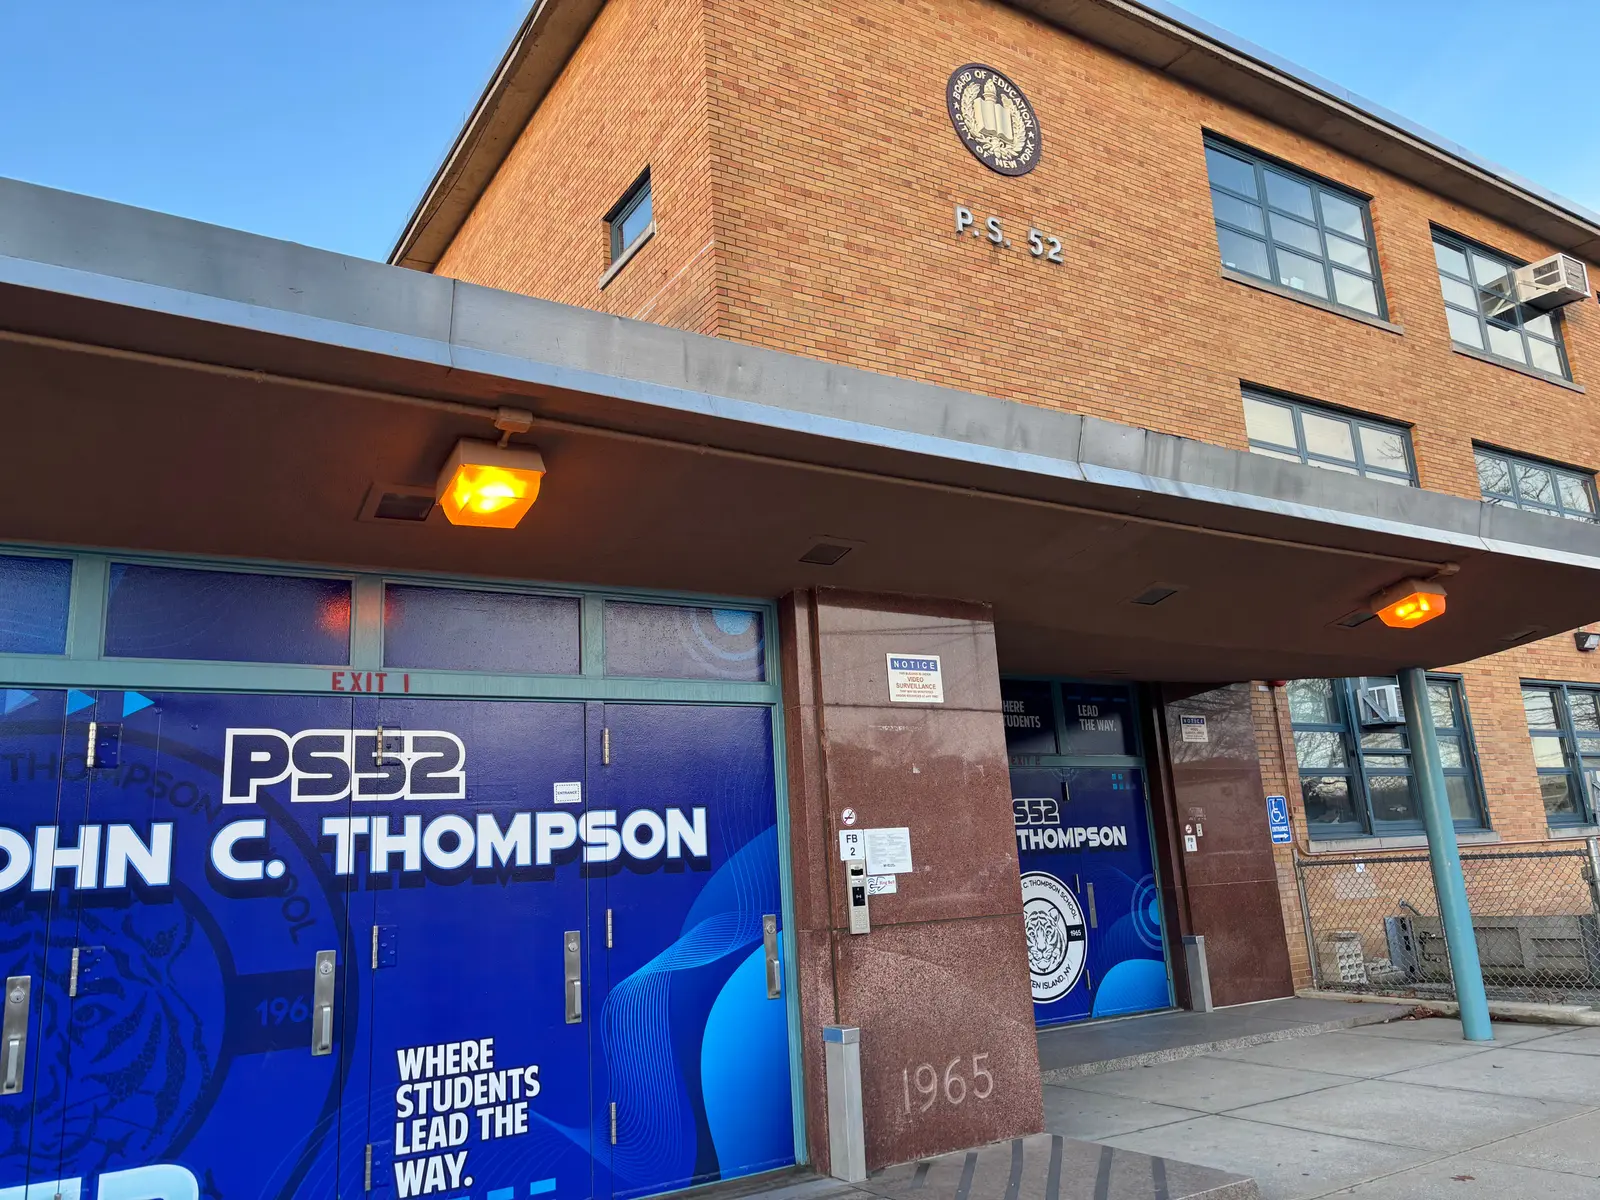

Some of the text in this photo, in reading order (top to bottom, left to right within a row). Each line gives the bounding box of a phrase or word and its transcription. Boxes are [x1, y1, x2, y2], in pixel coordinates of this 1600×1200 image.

[953, 70, 1033, 127] BOARD OF EDUCATION
[955, 113, 1035, 169] CITY OF NEW YORK
[1028, 227, 1064, 264] 52
[893, 660, 936, 670] NOTICE
[331, 671, 388, 693] EXIT
[1003, 700, 1025, 713] HERE
[1004, 715, 1041, 728] UDENTS
[1077, 704, 1099, 717] LEAD
[1079, 718, 1117, 732] THE WAY.
[222, 728, 466, 805] PS52
[1012, 798, 1060, 825] S52
[0, 807, 708, 893] OHN C. THOMPSON
[846, 834, 858, 843] FB
[850, 847, 856, 856] 2
[1016, 826, 1127, 850] THOMPSON
[1029, 879, 1061, 894] THOMPSON
[1060, 892, 1078, 920] SCHOOL
[1070, 929, 1082, 937] 1965
[1063, 964, 1072, 976] NY
[254, 994, 313, 1027] 196
[397, 1037, 494, 1081] WHERE
[395, 1065, 541, 1118] STUDENTS
[903, 1052, 993, 1115] 1965
[395, 1101, 528, 1156] LEAD THE
[394, 1150, 474, 1199] WAY.
